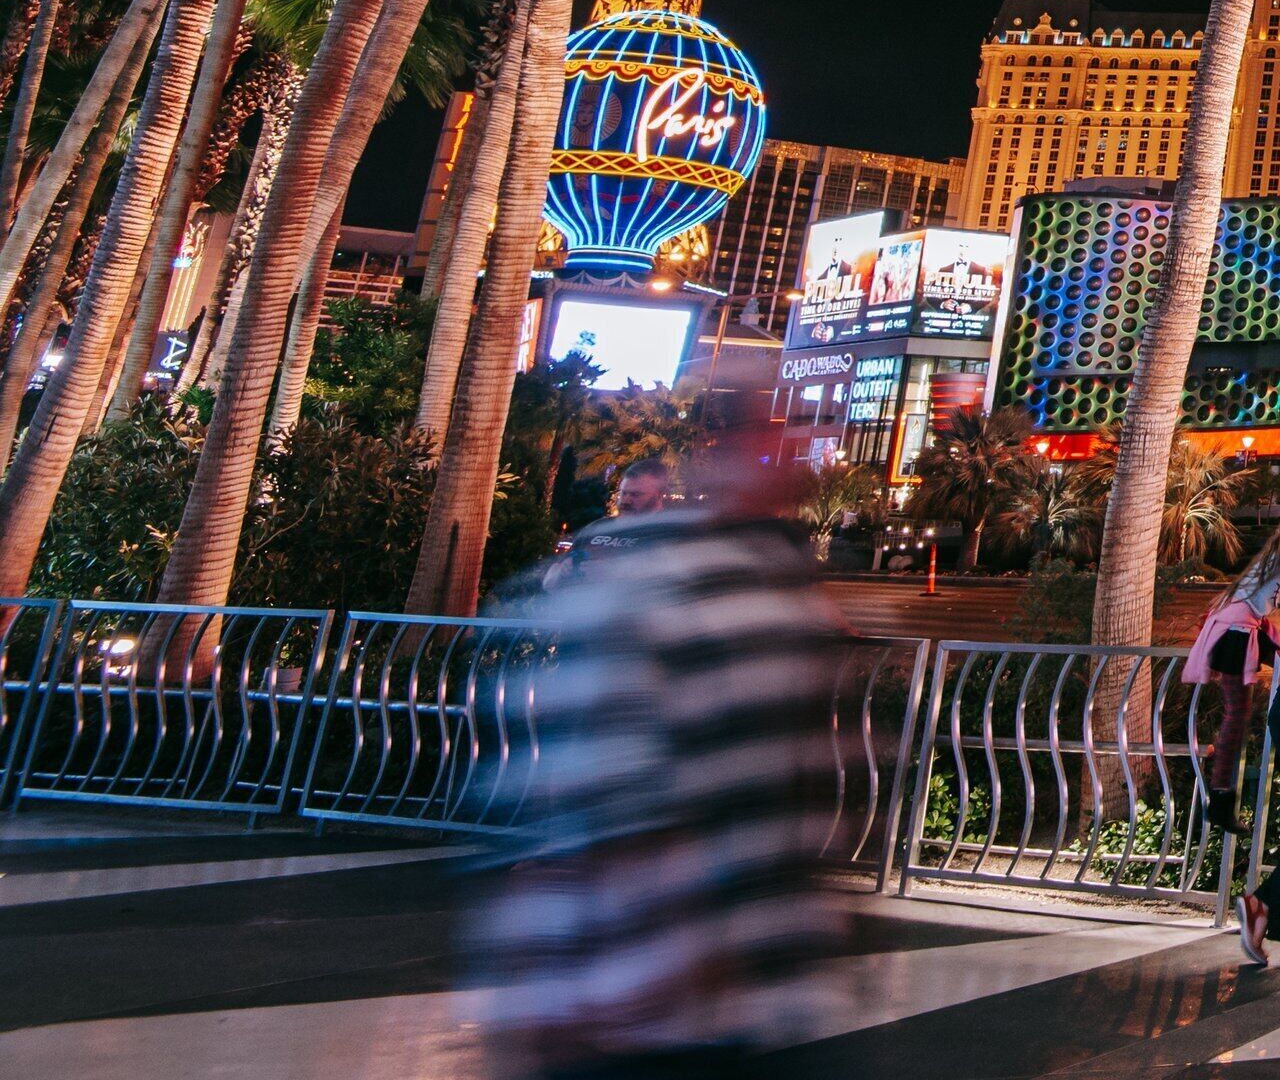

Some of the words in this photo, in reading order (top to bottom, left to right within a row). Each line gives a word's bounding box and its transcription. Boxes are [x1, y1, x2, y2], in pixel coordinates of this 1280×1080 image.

[637, 67, 736, 163] Paris
[802, 273, 864, 305] PITBULL
[923, 271, 998, 290] PITBULL
[782, 357, 816, 381] CABO
[856, 358, 895, 378] URBAN
[853, 379, 893, 399] OUTFIT
[850, 402, 877, 420] TERS
